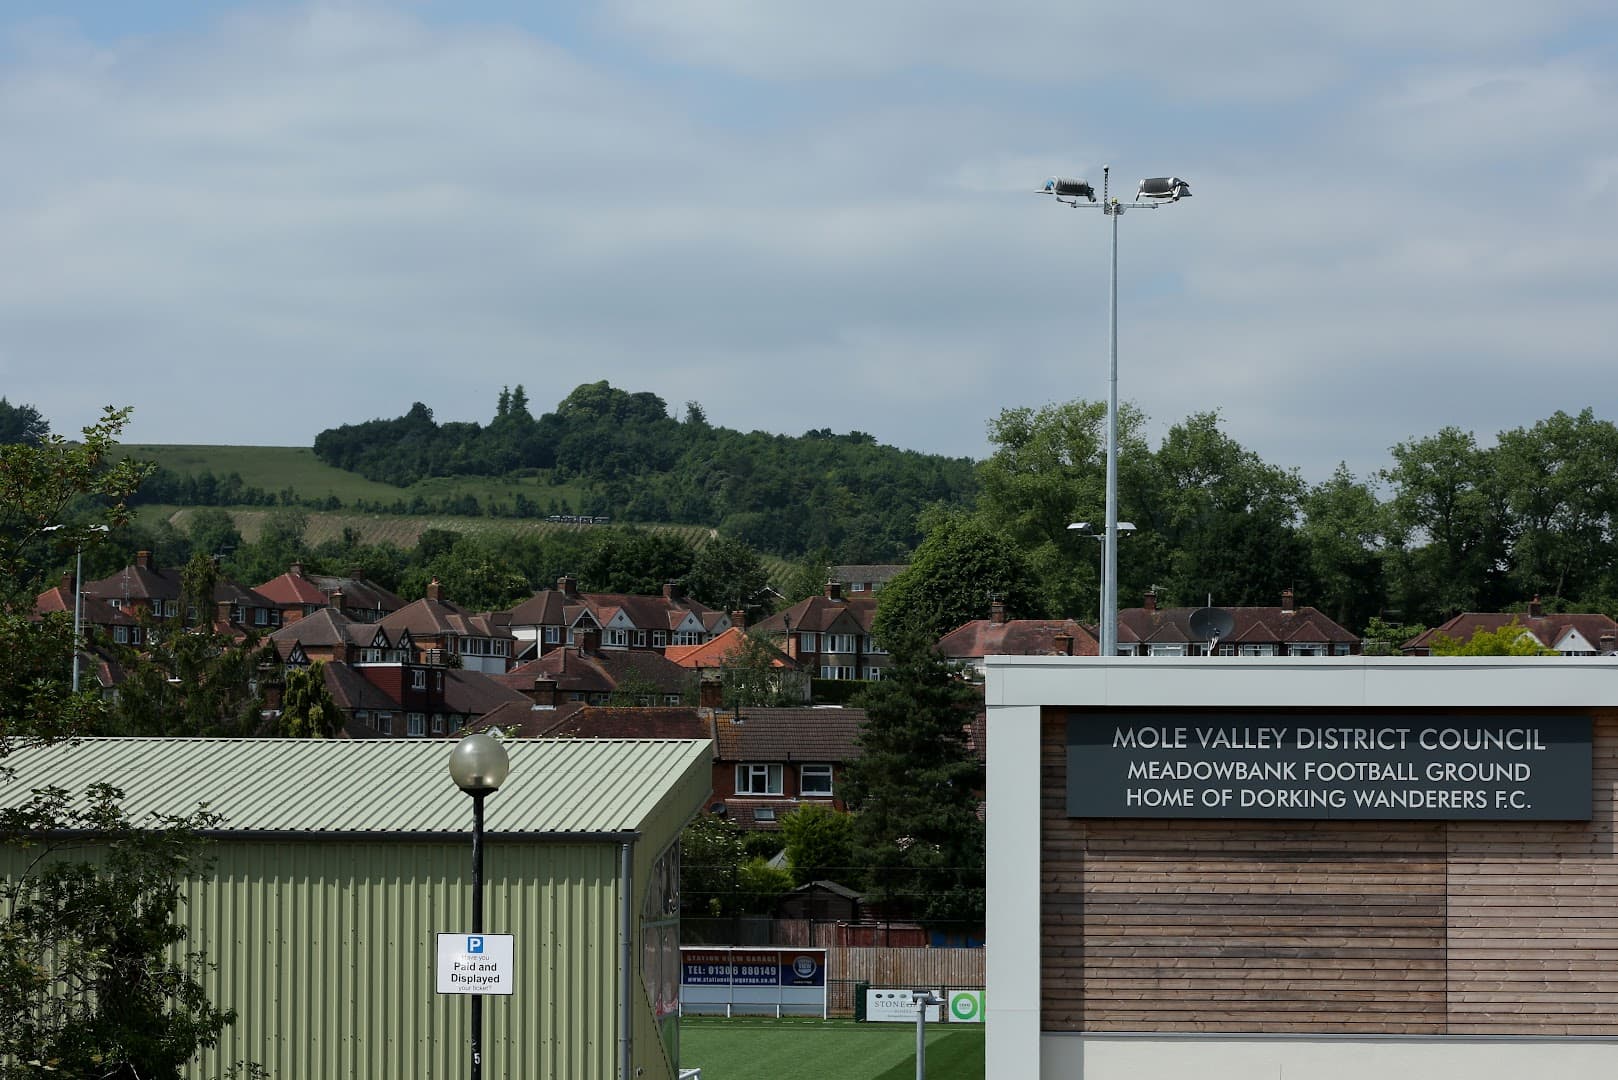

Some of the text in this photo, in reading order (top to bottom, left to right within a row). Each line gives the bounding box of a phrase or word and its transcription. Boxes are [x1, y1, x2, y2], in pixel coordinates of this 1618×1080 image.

[1112, 726, 1547, 752] MOLE VALLEY DISTRICT COUNCIL
[1127, 760, 1532, 783] MEADOWBANK FOOTBALL GROUND
[1126, 787, 1533, 810] HOME OF DORKING WANDERERS F.C.
[469, 938, 481, 952] P
[454, 961, 497, 972] Paid and
[687, 965, 777, 976] TEL: 01306 880149
[451, 973, 500, 985] Displayed
